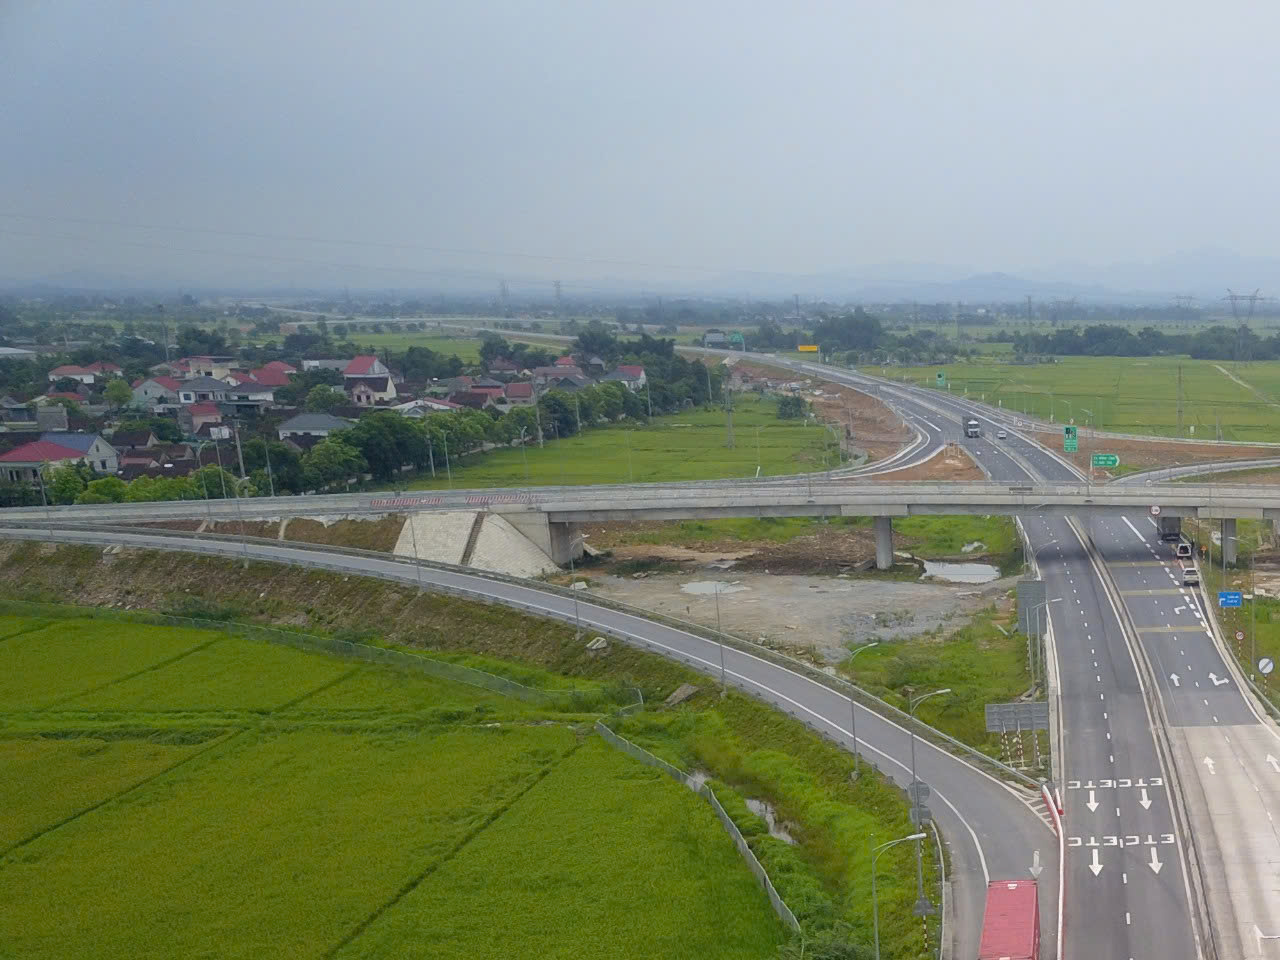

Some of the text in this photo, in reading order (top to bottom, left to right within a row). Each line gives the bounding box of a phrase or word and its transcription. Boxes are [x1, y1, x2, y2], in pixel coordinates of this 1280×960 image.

[1067, 779, 1113, 789] ETC
[1119, 777, 1163, 788] ETC
[1067, 836, 1118, 847] ETC
[1125, 833, 1175, 846] ETC
